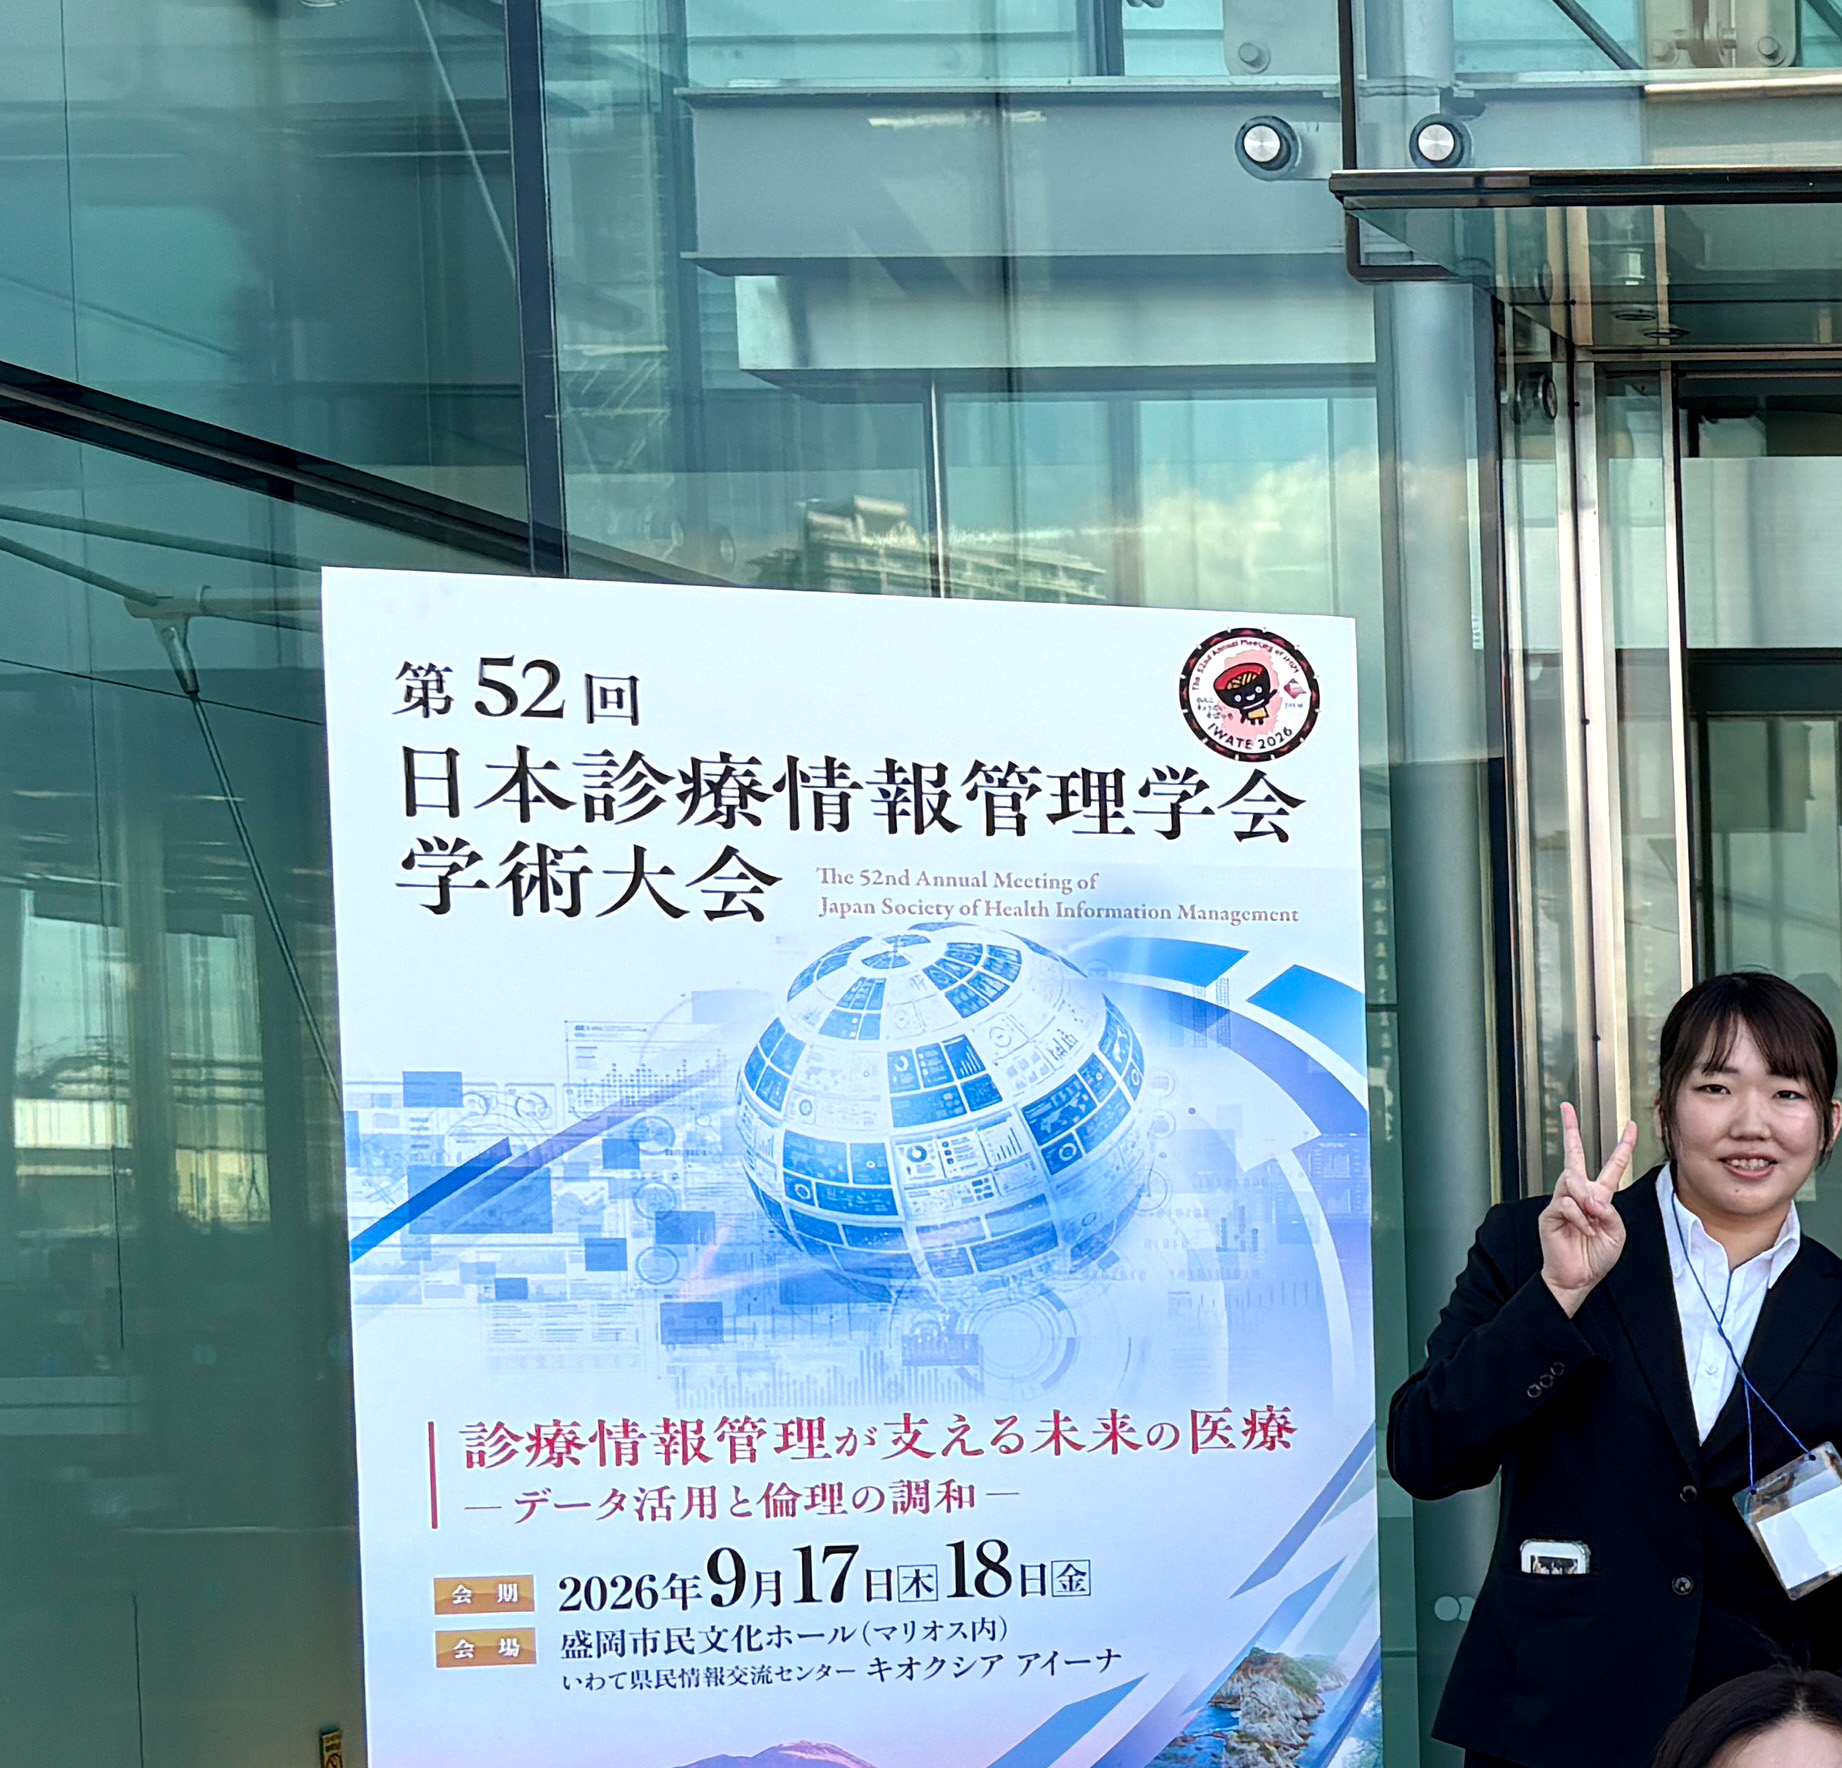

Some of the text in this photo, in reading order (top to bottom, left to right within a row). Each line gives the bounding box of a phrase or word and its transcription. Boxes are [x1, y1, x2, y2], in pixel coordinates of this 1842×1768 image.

[1207, 722, 1293, 750] IWATE 2026
[402, 745, 1306, 843] 日本診療情報管理学会
[395, 836, 783, 922] 学術大会
[817, 866, 1100, 895] The 52nd Annual Meeting of
[819, 897, 1300, 926] Japan Society of Health Information Management
[458, 1404, 1298, 1470] 診療情報管理が支える未来の医療
[451, 1582, 519, 1604] 会期
[452, 1638, 520, 1660] 会場
[562, 1647, 1122, 1692] いわて県民情報交流センター キオクシア アイーナ
